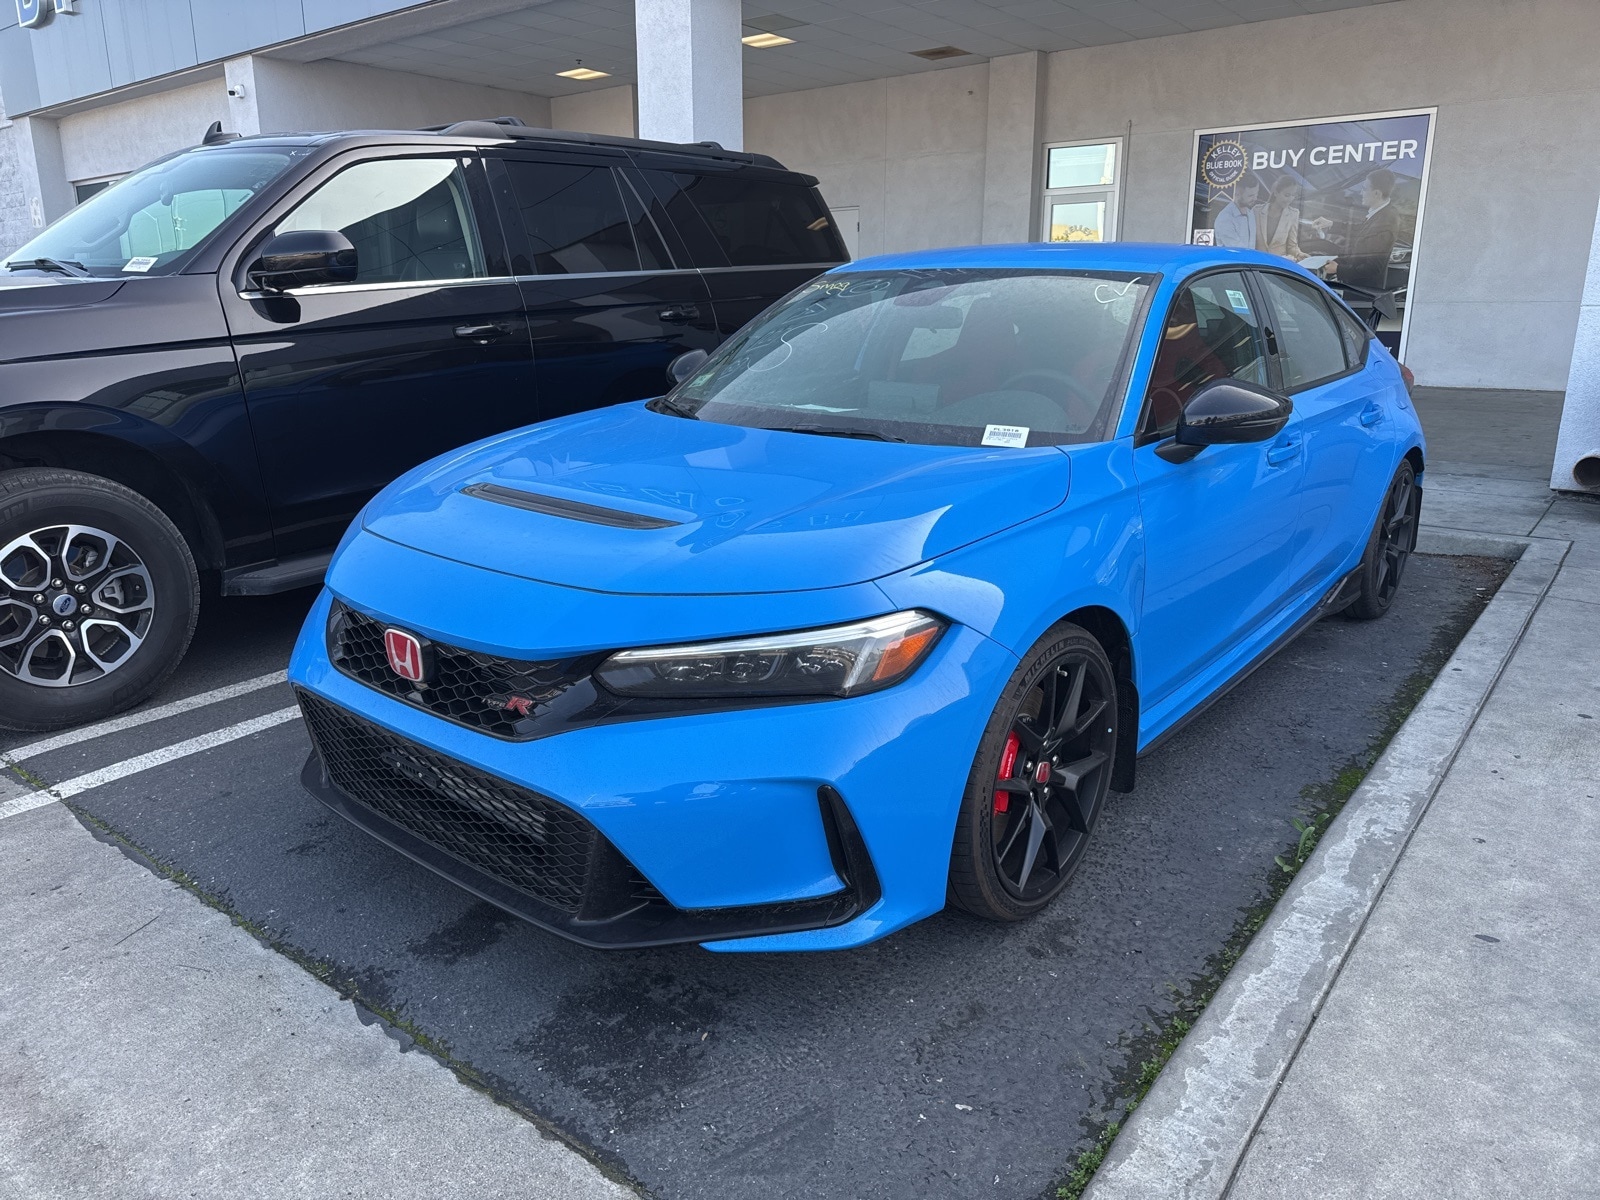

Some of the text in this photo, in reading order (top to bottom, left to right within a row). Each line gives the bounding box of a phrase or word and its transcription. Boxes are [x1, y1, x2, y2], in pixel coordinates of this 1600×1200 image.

[1211, 146, 1241, 159] KELLEY
[1253, 139, 1418, 170] BUY CENTER
[1206, 160, 1242, 170] BLUE BOOK
[1209, 171, 1226, 182] OFFICIAL
[1063, 225, 1093, 237] KELLEY
[1024, 640, 1066, 684] MICHELIN
[505, 695, 533, 715] R
